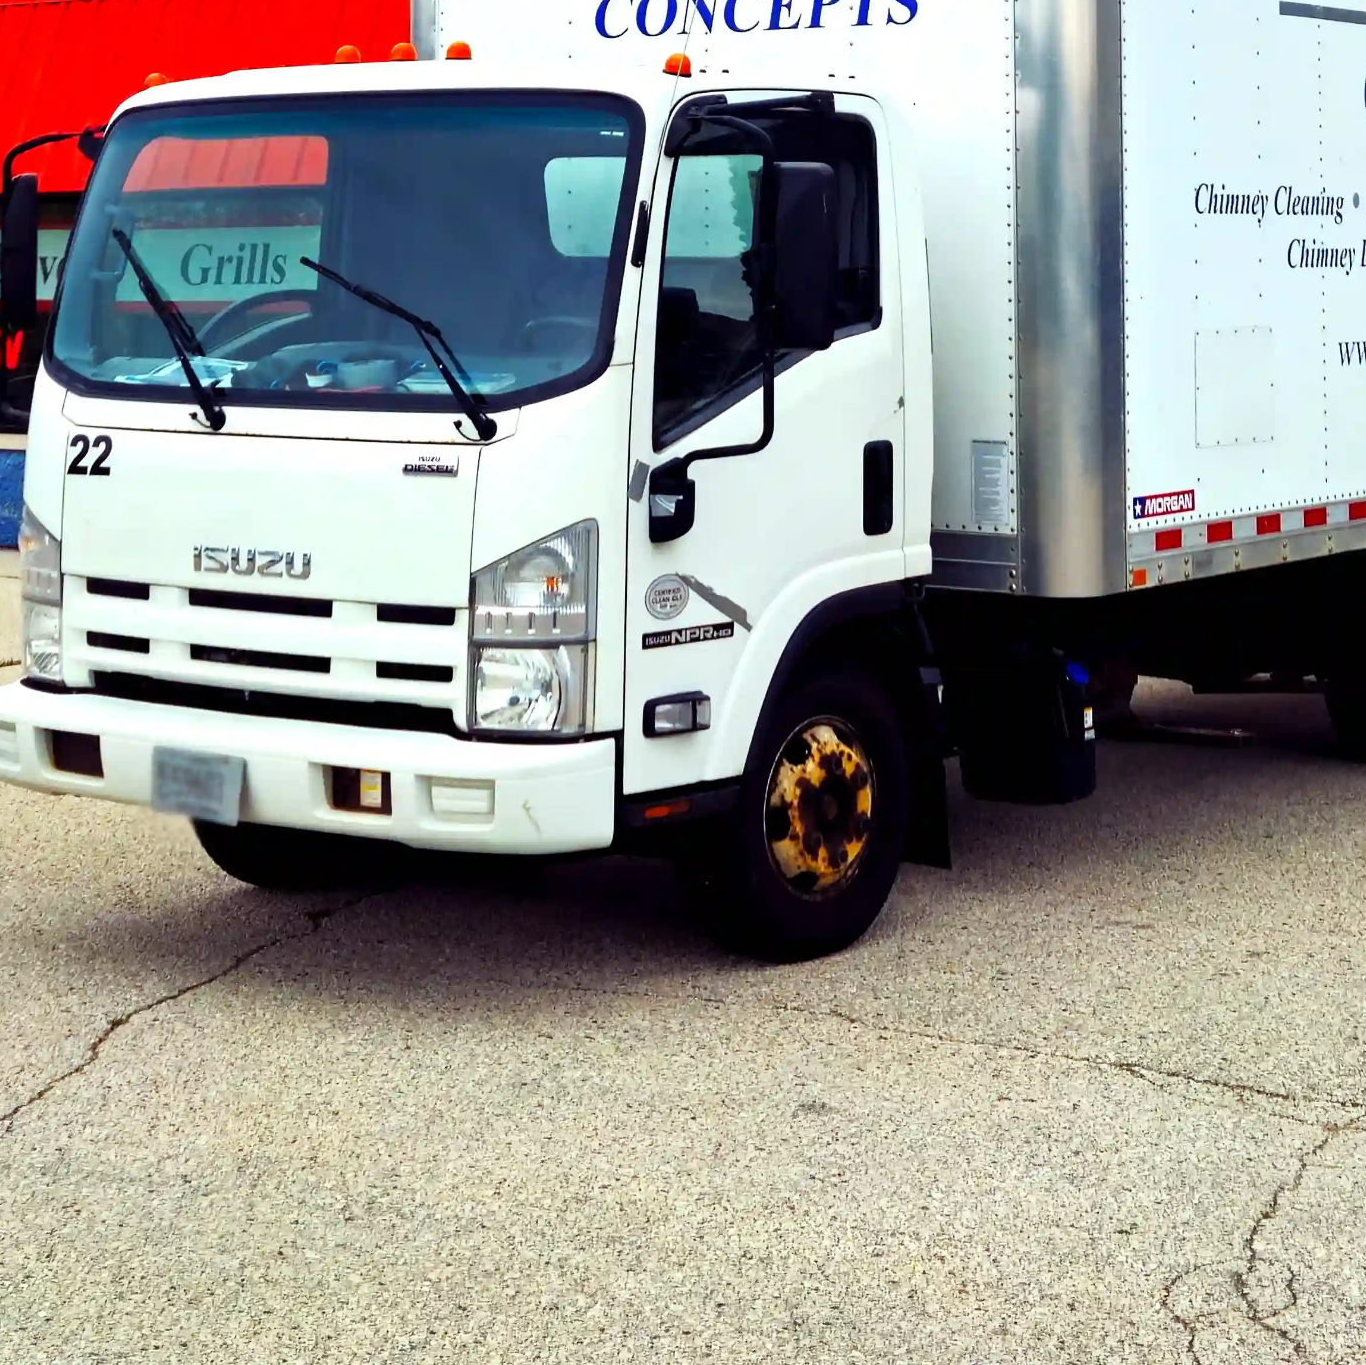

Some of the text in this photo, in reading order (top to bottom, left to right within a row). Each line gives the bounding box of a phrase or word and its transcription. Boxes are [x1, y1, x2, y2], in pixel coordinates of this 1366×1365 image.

[1194, 183, 1269, 223] Chimney
[1274, 186, 1344, 224] Cleaning
[180, 242, 287, 286] Grills
[1287, 238, 1356, 276] Chimney
[68, 435, 111, 475] 22
[404, 464, 455, 474] DIESEL
[1144, 493, 1193, 515] MORGAN
[192, 544, 312, 580] ISUZU
[645, 634, 670, 646] ISUZU
[671, 626, 714, 644] NPR
